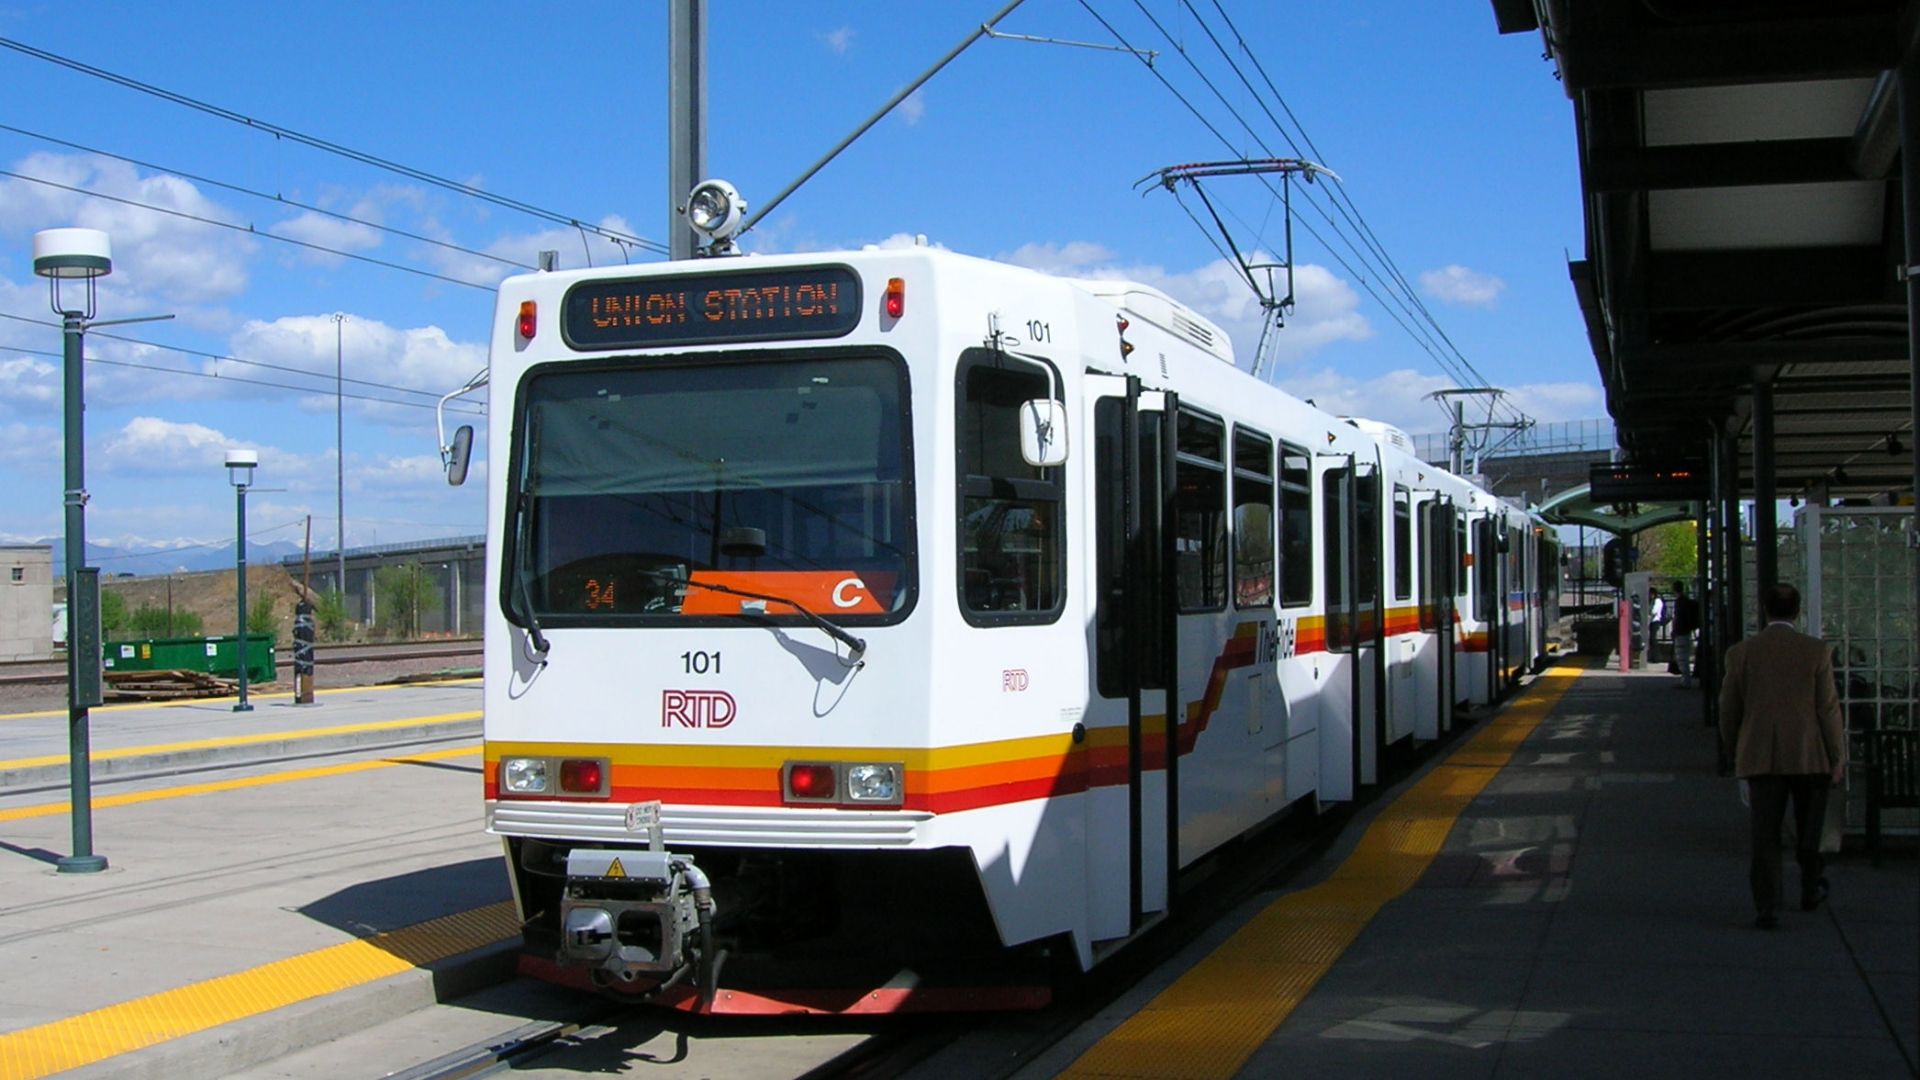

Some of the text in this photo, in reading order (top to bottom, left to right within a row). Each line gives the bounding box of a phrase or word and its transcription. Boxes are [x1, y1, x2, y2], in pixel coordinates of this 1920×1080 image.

[591, 283, 838, 327] UNION STATION
[1026, 320, 1051, 344] 101
[585, 580, 614, 609] 34
[832, 578, 865, 608] C
[681, 651, 721, 674] 101
[1002, 669, 1029, 692] RTD
[662, 689, 737, 728] RTD
